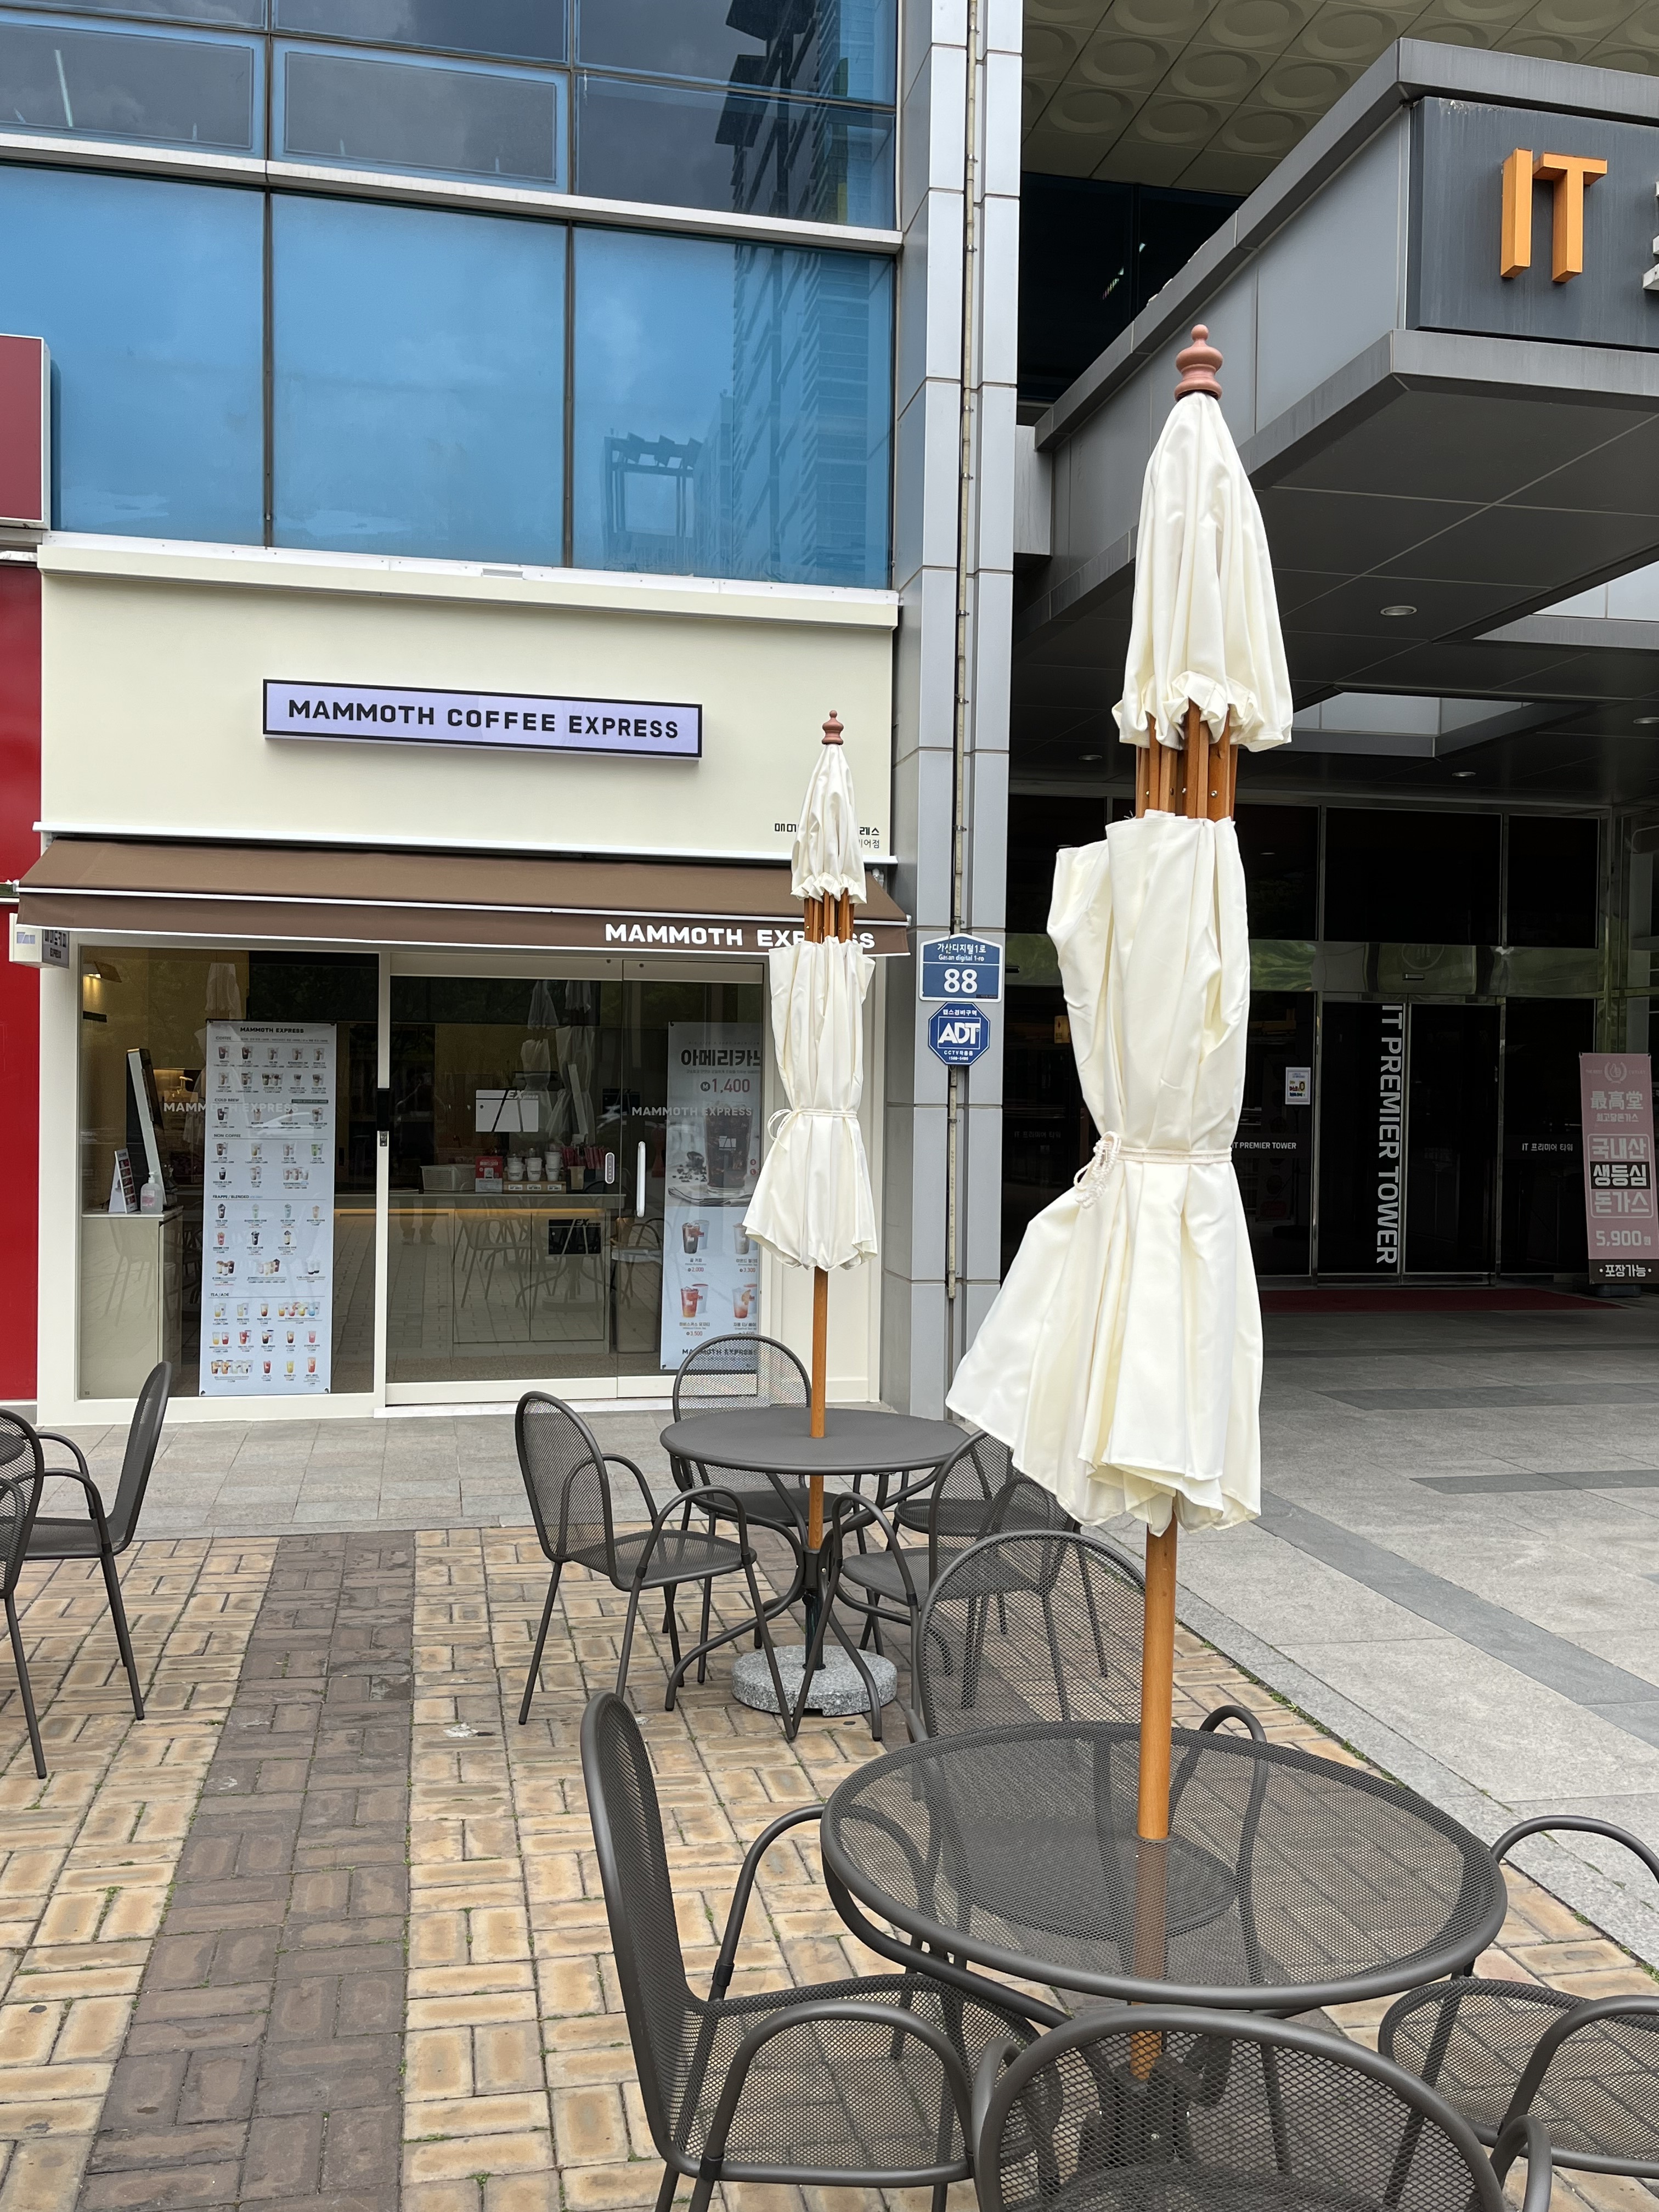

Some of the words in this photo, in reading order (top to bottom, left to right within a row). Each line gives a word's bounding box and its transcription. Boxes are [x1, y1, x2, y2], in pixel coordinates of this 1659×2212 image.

[1501, 147, 1608, 283] IT
[289, 699, 435, 725] MAMMOTH
[447, 708, 556, 732] COFFEE
[568, 715, 679, 738] EXPRESS
[605, 923, 743, 946] MAMMOTH
[937, 943, 986, 955] 가산디지털1로
[956, 955, 973, 963] digital
[944, 968, 978, 994] 88
[1382, 1005, 1403, 1029] IT
[938, 1022, 981, 1045] ADT
[712, 1078, 750, 1093] 1,400
[242, 1103, 299, 1113] EXPRESS
[1379, 1037, 1402, 1158] PREMIER
[1590, 1090, 1644, 1110] 最高堂
[631, 1107, 697, 1116] MAMMOTH
[702, 1107, 752, 1116] EXPRESS
[1522, 1143, 1528, 1152] IT
[1531, 1143, 1558, 1152] 프리미어
[1560, 1143, 1573, 1152] 타워
[1592, 1137, 1646, 1160] 국내산
[1593, 1164, 1647, 1186] 생등심
[1594, 1192, 1650, 1213] 돈가스
[1376, 1166, 1400, 1263] TOWER
[1605, 1264, 1646, 1278] 포장가능
